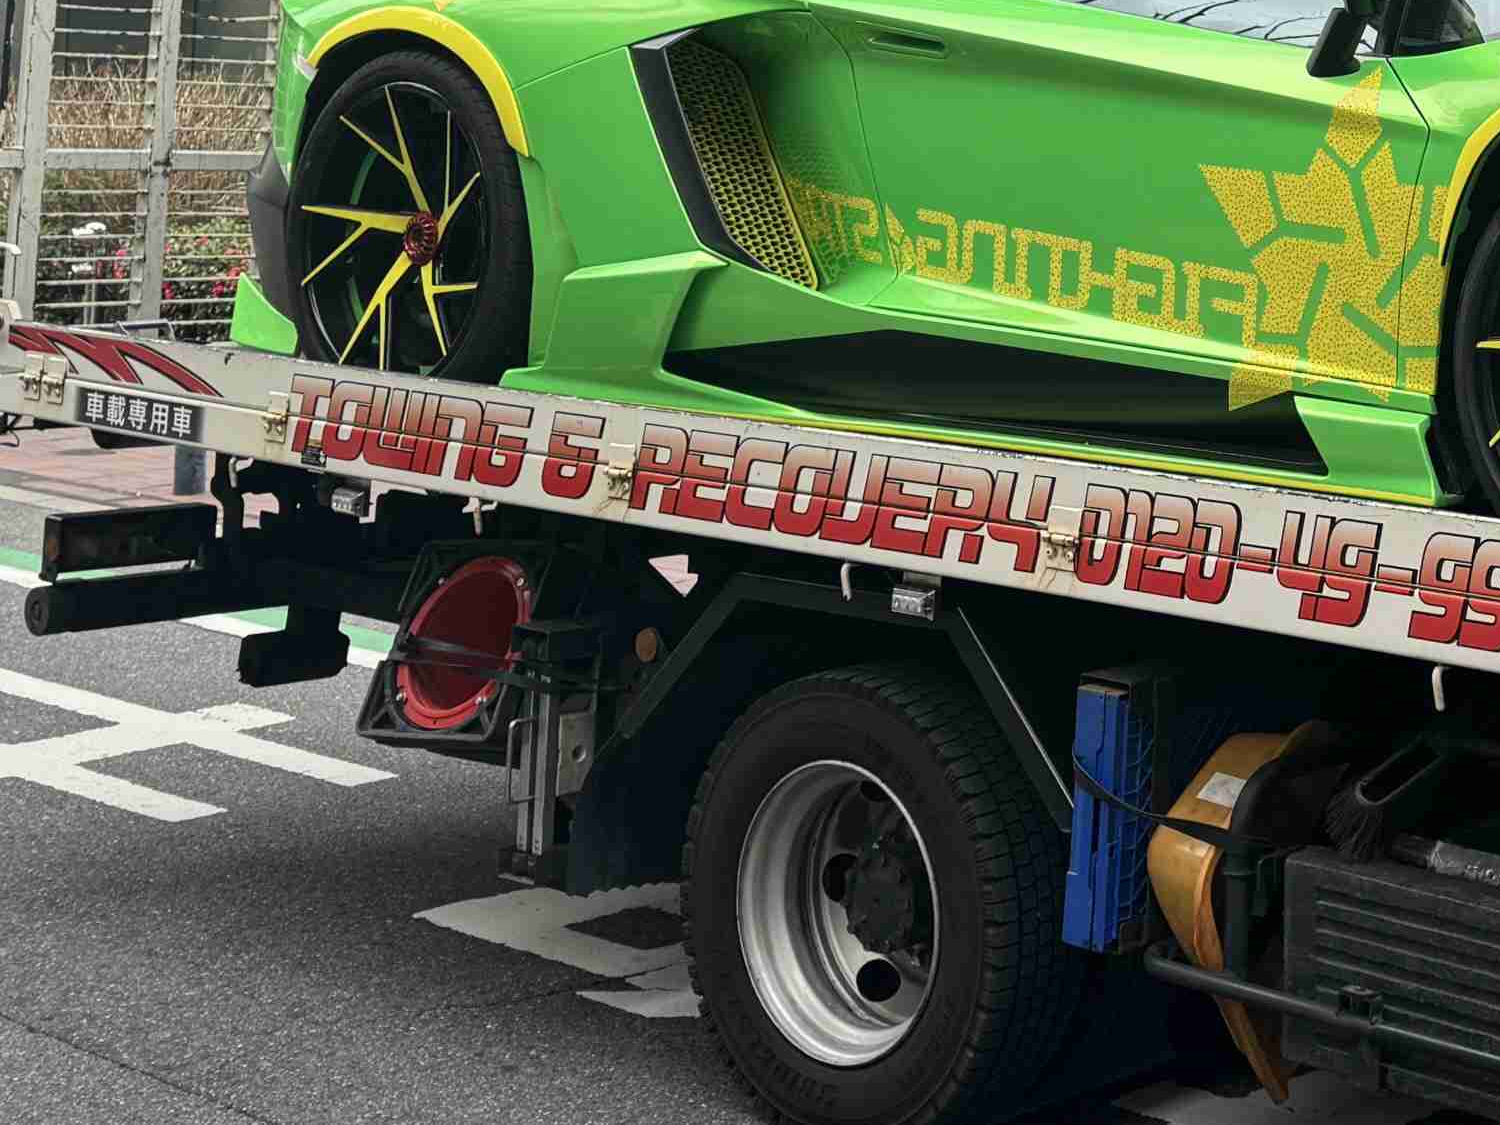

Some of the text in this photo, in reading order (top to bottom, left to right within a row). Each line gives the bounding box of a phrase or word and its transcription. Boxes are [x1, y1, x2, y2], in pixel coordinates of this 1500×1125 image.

[85, 392, 193, 437] 車載専用車
[291, 373, 535, 488] TOWING
[628, 423, 1056, 572] RECOVERY
